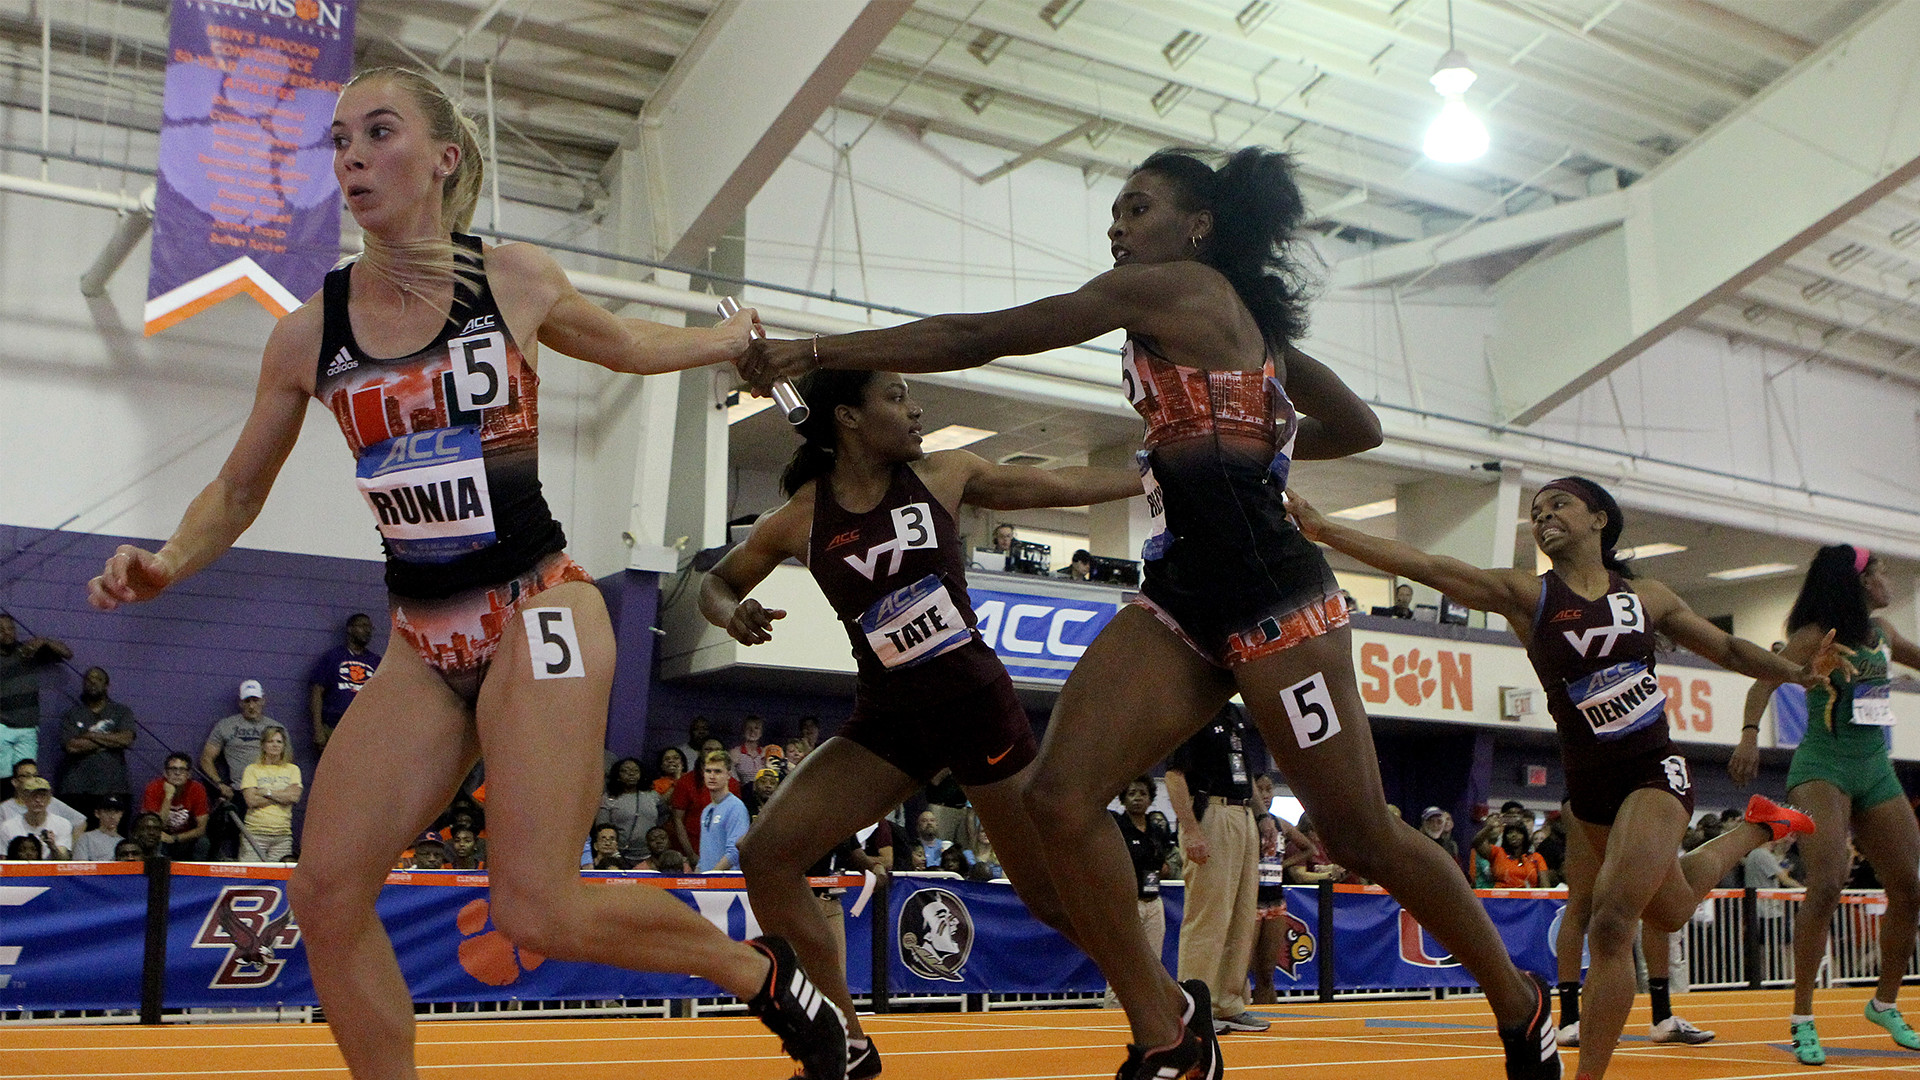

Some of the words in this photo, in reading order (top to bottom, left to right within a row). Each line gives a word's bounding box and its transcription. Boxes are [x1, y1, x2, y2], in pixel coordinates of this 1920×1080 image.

[207, 25, 255, 44] MEN'S
[260, 35, 319, 59] INDOOR
[210, 40, 313, 73] CONFERENCE
[223, 77, 296, 101] ATHLETES
[461, 314, 495, 333] ACC
[327, 360, 359, 377] adidas
[462, 338, 499, 405] 5
[379, 428, 463, 468] ACC
[368, 477, 485, 525] RUNIA
[828, 528, 861, 548] ACC
[900, 506, 928, 547] 3
[1553, 609, 1583, 620] ACC
[1617, 594, 1639, 627] 3
[538, 611, 571, 675] 5
[884, 605, 949, 653] TATE
[974, 601, 1098, 658] ACC
[1563, 625, 1634, 657] VT
[1587, 662, 1636, 696] ACC
[1292, 681, 1329, 742] 5
[1585, 676, 1657, 728] DENNIS
